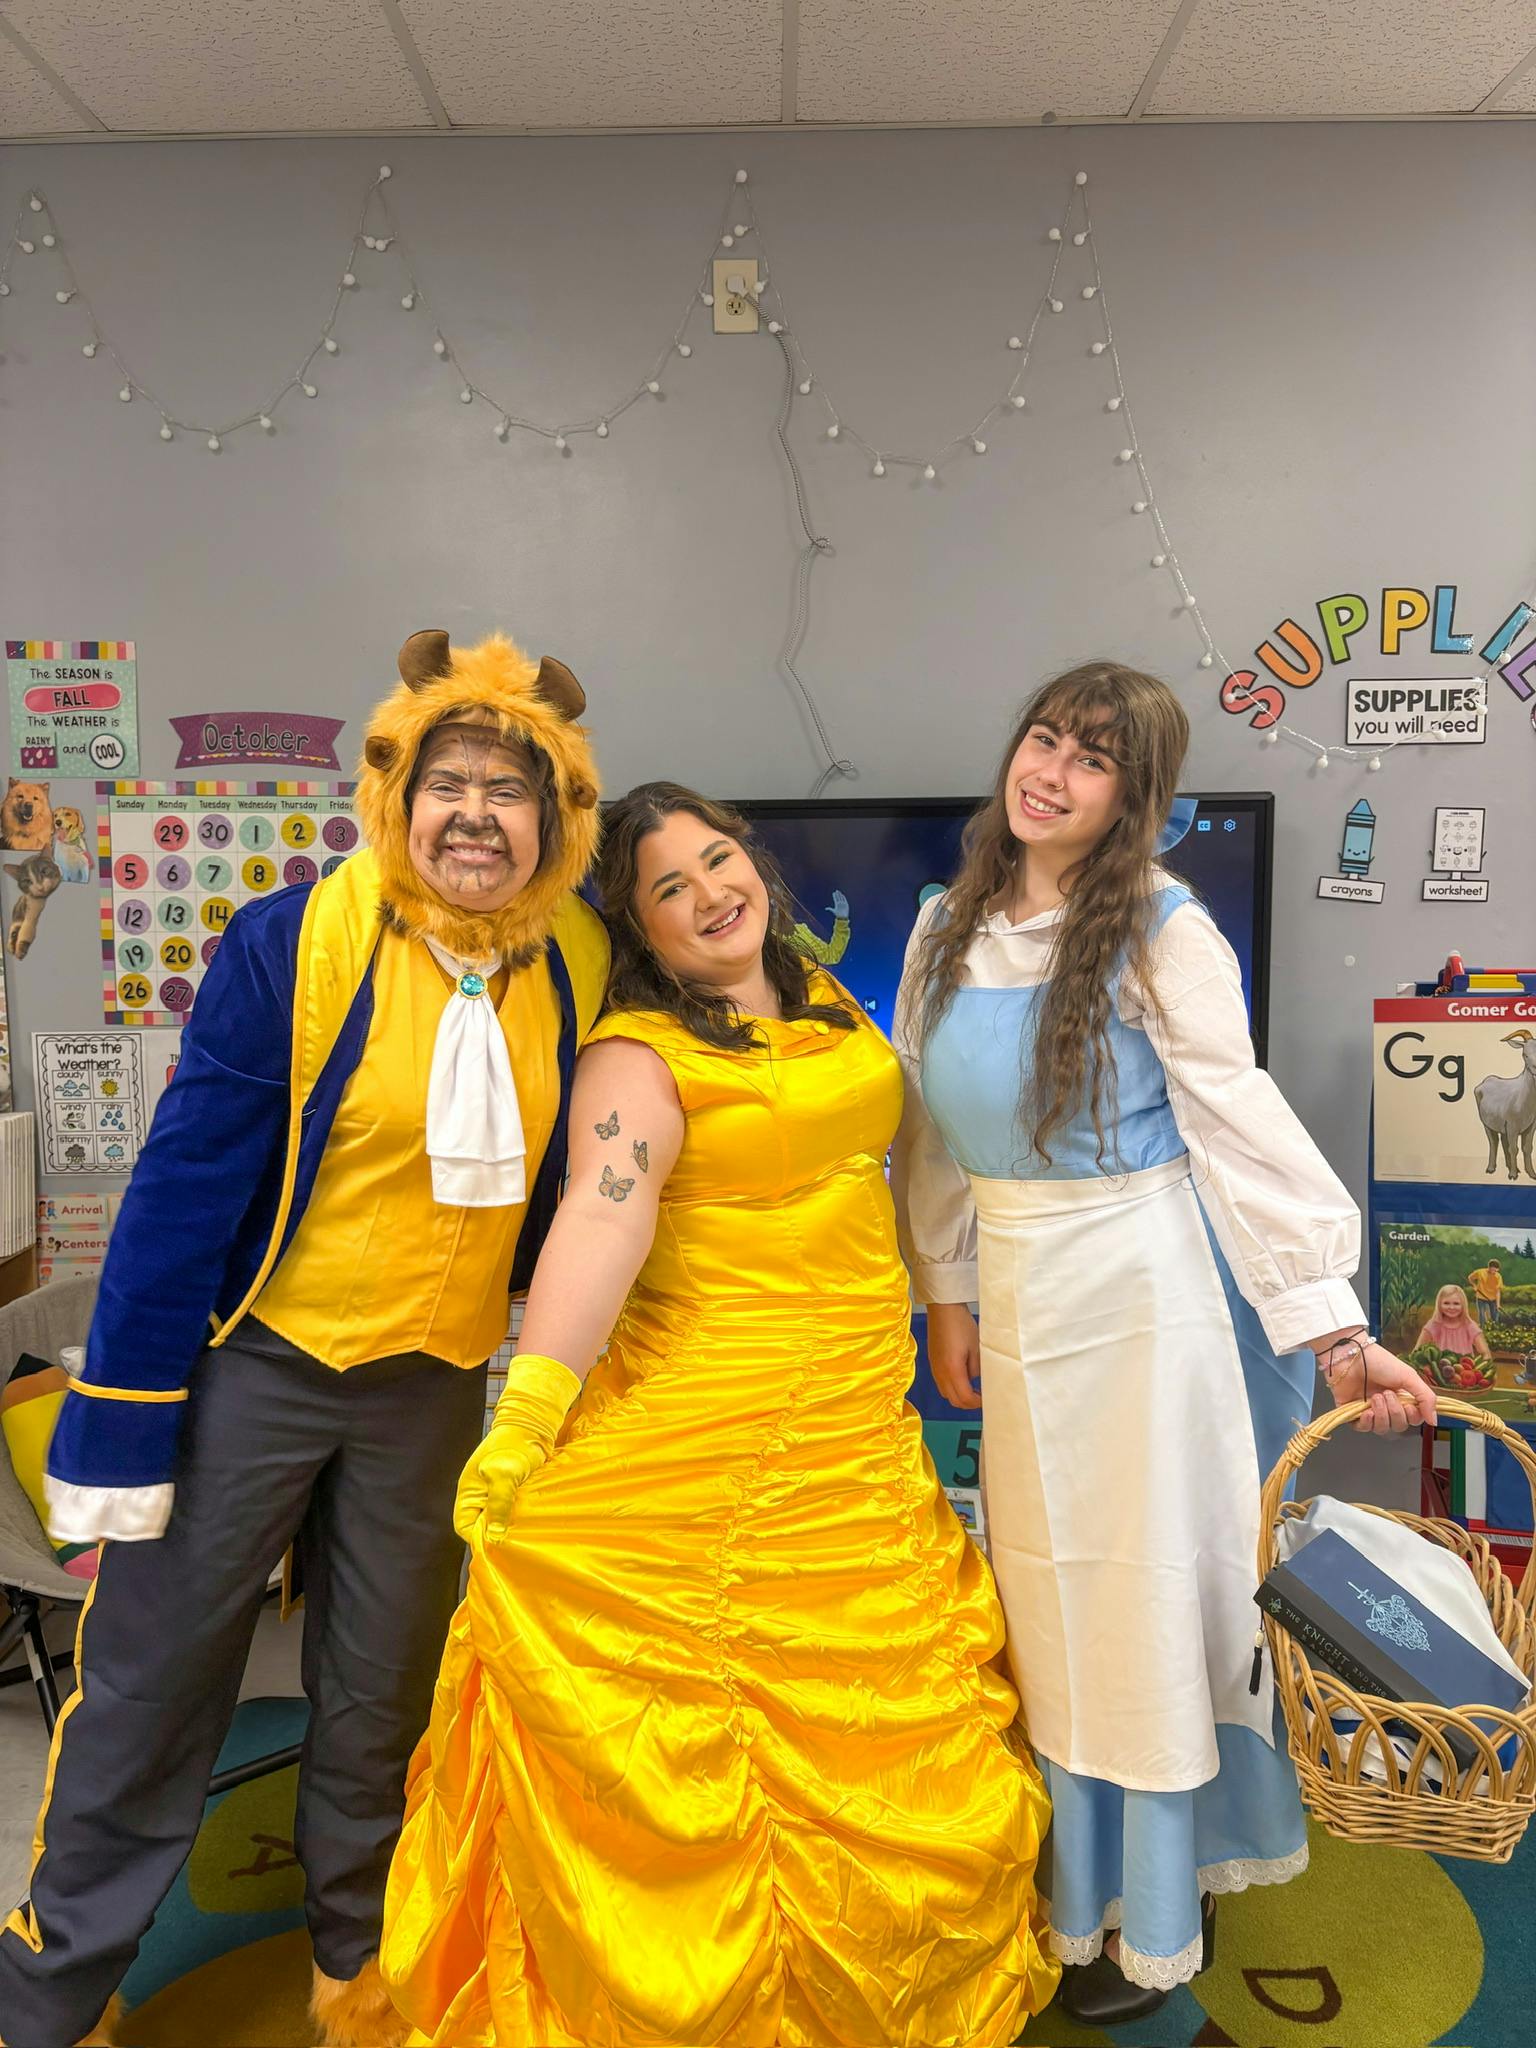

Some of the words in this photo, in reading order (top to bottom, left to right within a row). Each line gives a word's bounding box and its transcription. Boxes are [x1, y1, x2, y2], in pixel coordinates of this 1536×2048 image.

[30, 668, 49, 679] The
[55, 668, 100, 679] SEASON
[105, 670, 113, 679] is
[54, 690, 90, 707] FALL
[1354, 688, 1479, 713] SUPPLIES
[27, 716, 47, 726] The
[52, 716, 107, 726] WEATHER
[111, 717, 119, 726] is
[1354, 720, 1388, 739] you
[1395, 716, 1423, 733] will
[26, 736, 50, 745] RAINY
[204, 722, 309, 752] October
[63, 744, 87, 754] and
[95, 742, 120, 760] COOL
[116, 800, 145, 810] Sunday
[158, 800, 188, 810] Monday
[200, 800, 231, 810] Tuesday
[238, 800, 277, 810] Wednesday
[281, 800, 318, 810] Thursday
[330, 800, 354, 811] Friday
[160, 825, 184, 842] 29
[201, 821, 229, 842] 30
[253, 825, 259, 844] 1
[292, 823, 305, 841] 2
[334, 826, 346, 843] 3
[124, 863, 137, 881] 5
[167, 865, 178, 882] 6
[207, 864, 221, 883] 7
[253, 865, 264, 883] 8
[295, 864, 305, 882] 9
[1331, 884, 1373, 897] crayons
[1429, 884, 1483, 897] worksheet
[125, 907, 143, 927] 12
[165, 904, 185, 924] 13
[208, 904, 228, 924] 14
[125, 945, 143, 967] 19
[165, 945, 191, 963] 20
[123, 982, 146, 999] 26
[165, 985, 189, 1003] 27
[1447, 1002, 1508, 1017] Gomer
[55, 1043, 98, 1054] What's
[101, 1042, 122, 1054] the
[58, 1059, 121, 1070] Weather?
[1383, 1031, 1465, 1103] Gg
[57, 1071, 84, 1080] cloudy
[97, 1071, 123, 1079] sunny
[60, 1104, 86, 1112] windy
[101, 1103, 124, 1111] rainy
[60, 1136, 91, 1145] stormy
[101, 1136, 129, 1145] snowy
[61, 1204, 103, 1214] Arrival
[1389, 1230, 1430, 1242] Garden
[62, 1240, 108, 1249] Centers
[952, 1429, 982, 1487] 5
[1286, 1608, 1301, 1624] THE
[1303, 1623, 1351, 1665] KNIGHT
[1241, 1966, 1343, 2025] D
